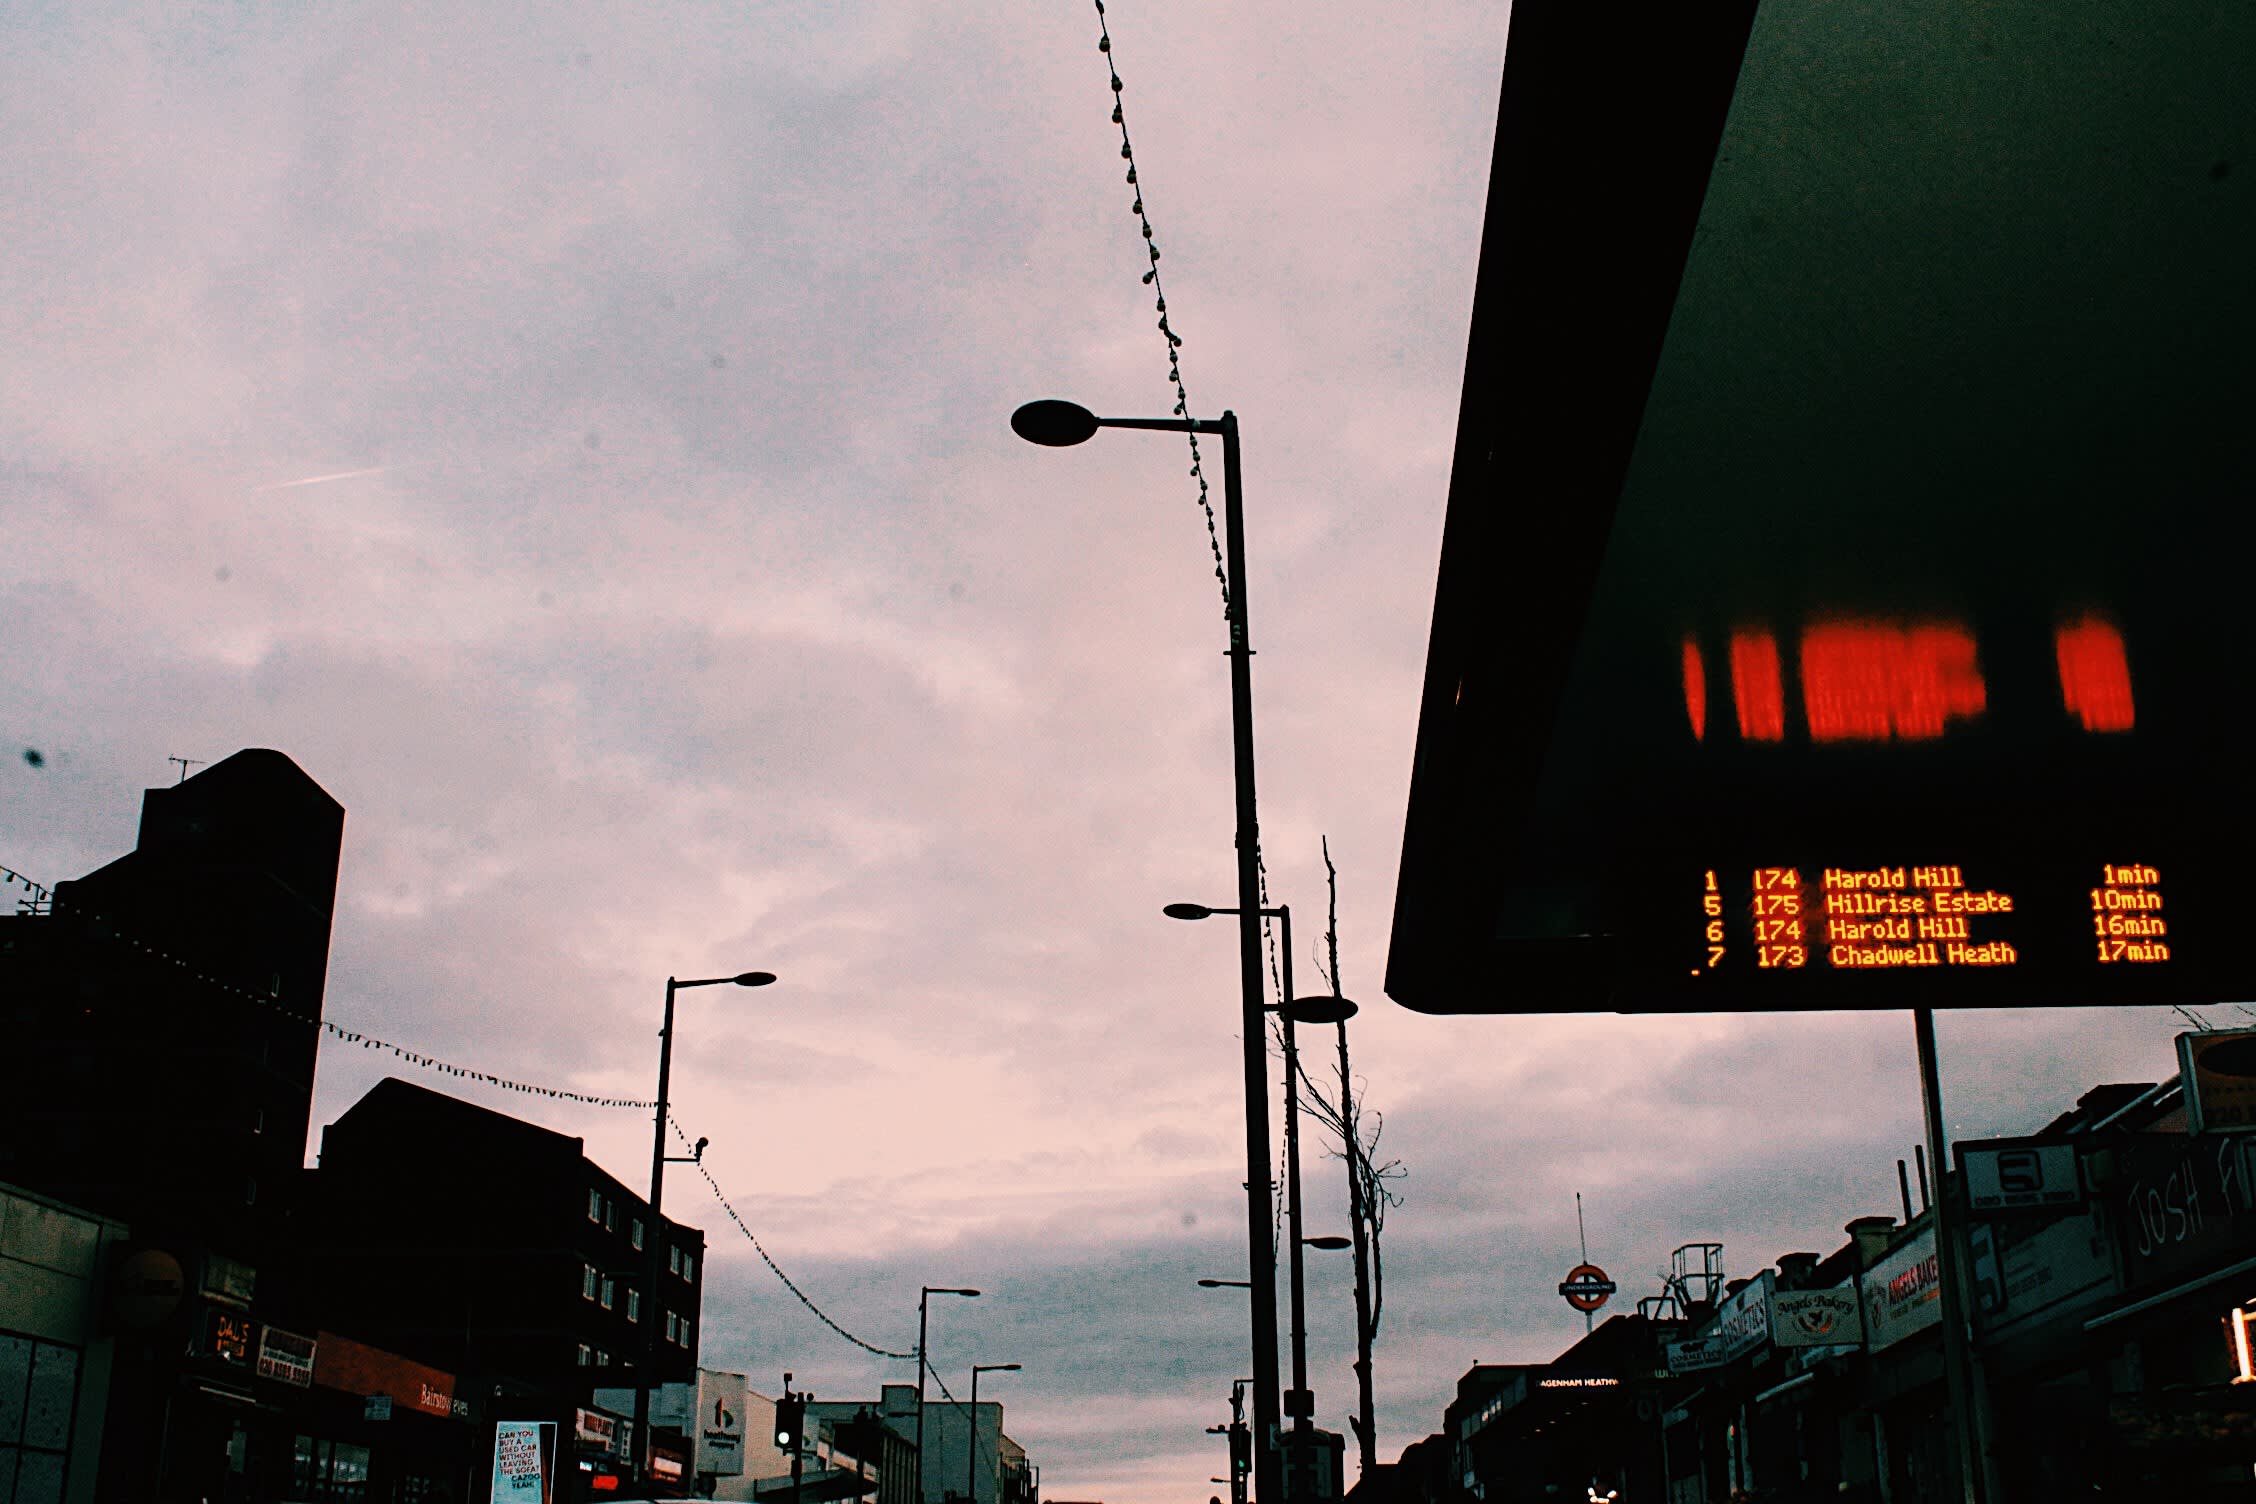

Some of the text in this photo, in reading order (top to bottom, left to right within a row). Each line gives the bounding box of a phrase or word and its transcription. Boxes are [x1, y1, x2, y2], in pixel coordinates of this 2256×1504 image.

[1705, 862, 2160, 892] 1 174 Harold Hill 1min
[1704, 887, 2163, 916] 5 175 Hillrise Estate 10min
[1706, 914, 2166, 942] 6 174 Harold Hill 16min
[1707, 939, 2169, 968] 7 173 Chadwell Heath 17min
[2127, 1157, 2204, 1257] JOSH
[1563, 1282, 1613, 1292] UNDERGROUND
[1778, 1294, 1855, 1316] Angels Bakery
[499, 1431, 515, 1439] CAN
[704, 1429, 741, 1444] heathway
[499, 1452, 536, 1460] WITHOUT
[500, 1459, 534, 1467] LEAVING
[500, 1467, 514, 1475] THE
[511, 1472, 540, 1481] CAZOO
